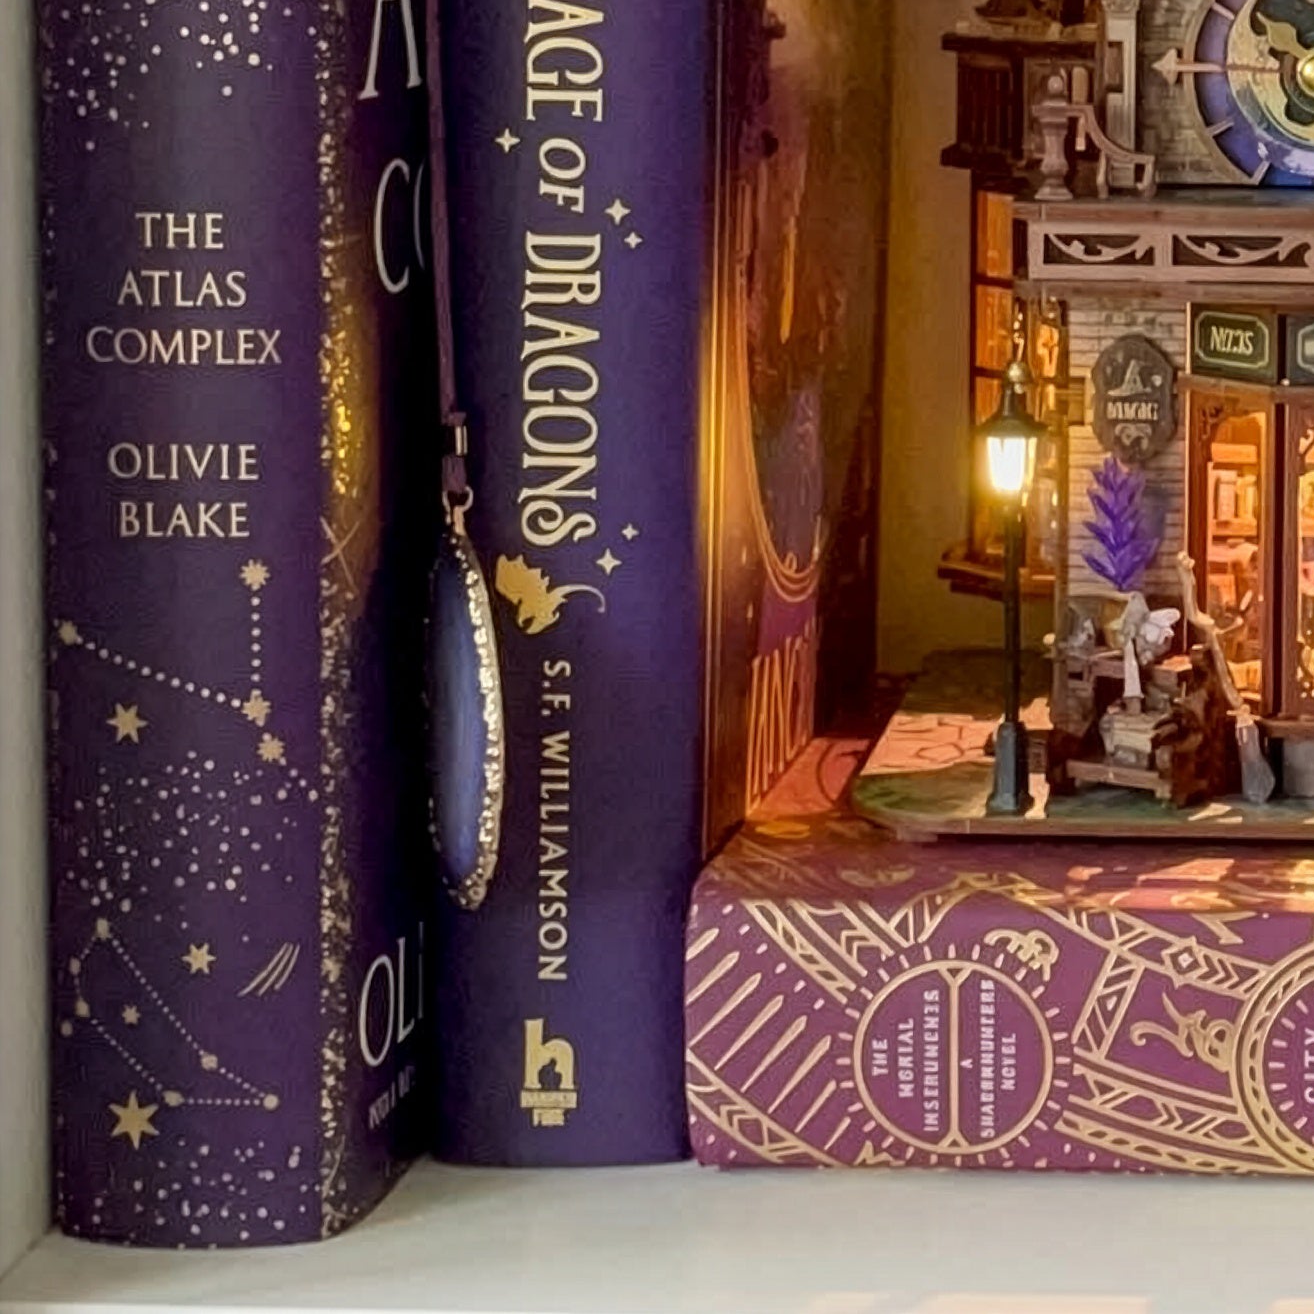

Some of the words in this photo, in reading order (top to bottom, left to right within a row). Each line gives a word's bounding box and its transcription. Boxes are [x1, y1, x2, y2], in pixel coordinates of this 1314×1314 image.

[538, 137, 587, 214] OF
[134, 212, 225, 250] THE
[117, 271, 247, 307] ATLAS
[86, 326, 282, 365] COMPLEX
[518, 231, 601, 546] DRAGONS
[107, 443, 260, 480] OLIVIE
[119, 502, 250, 538] BLAKE
[541, 660, 572, 717] S.F.
[538, 731, 570, 980] WILLIAMSON
[872, 1039, 888, 1076] THE
